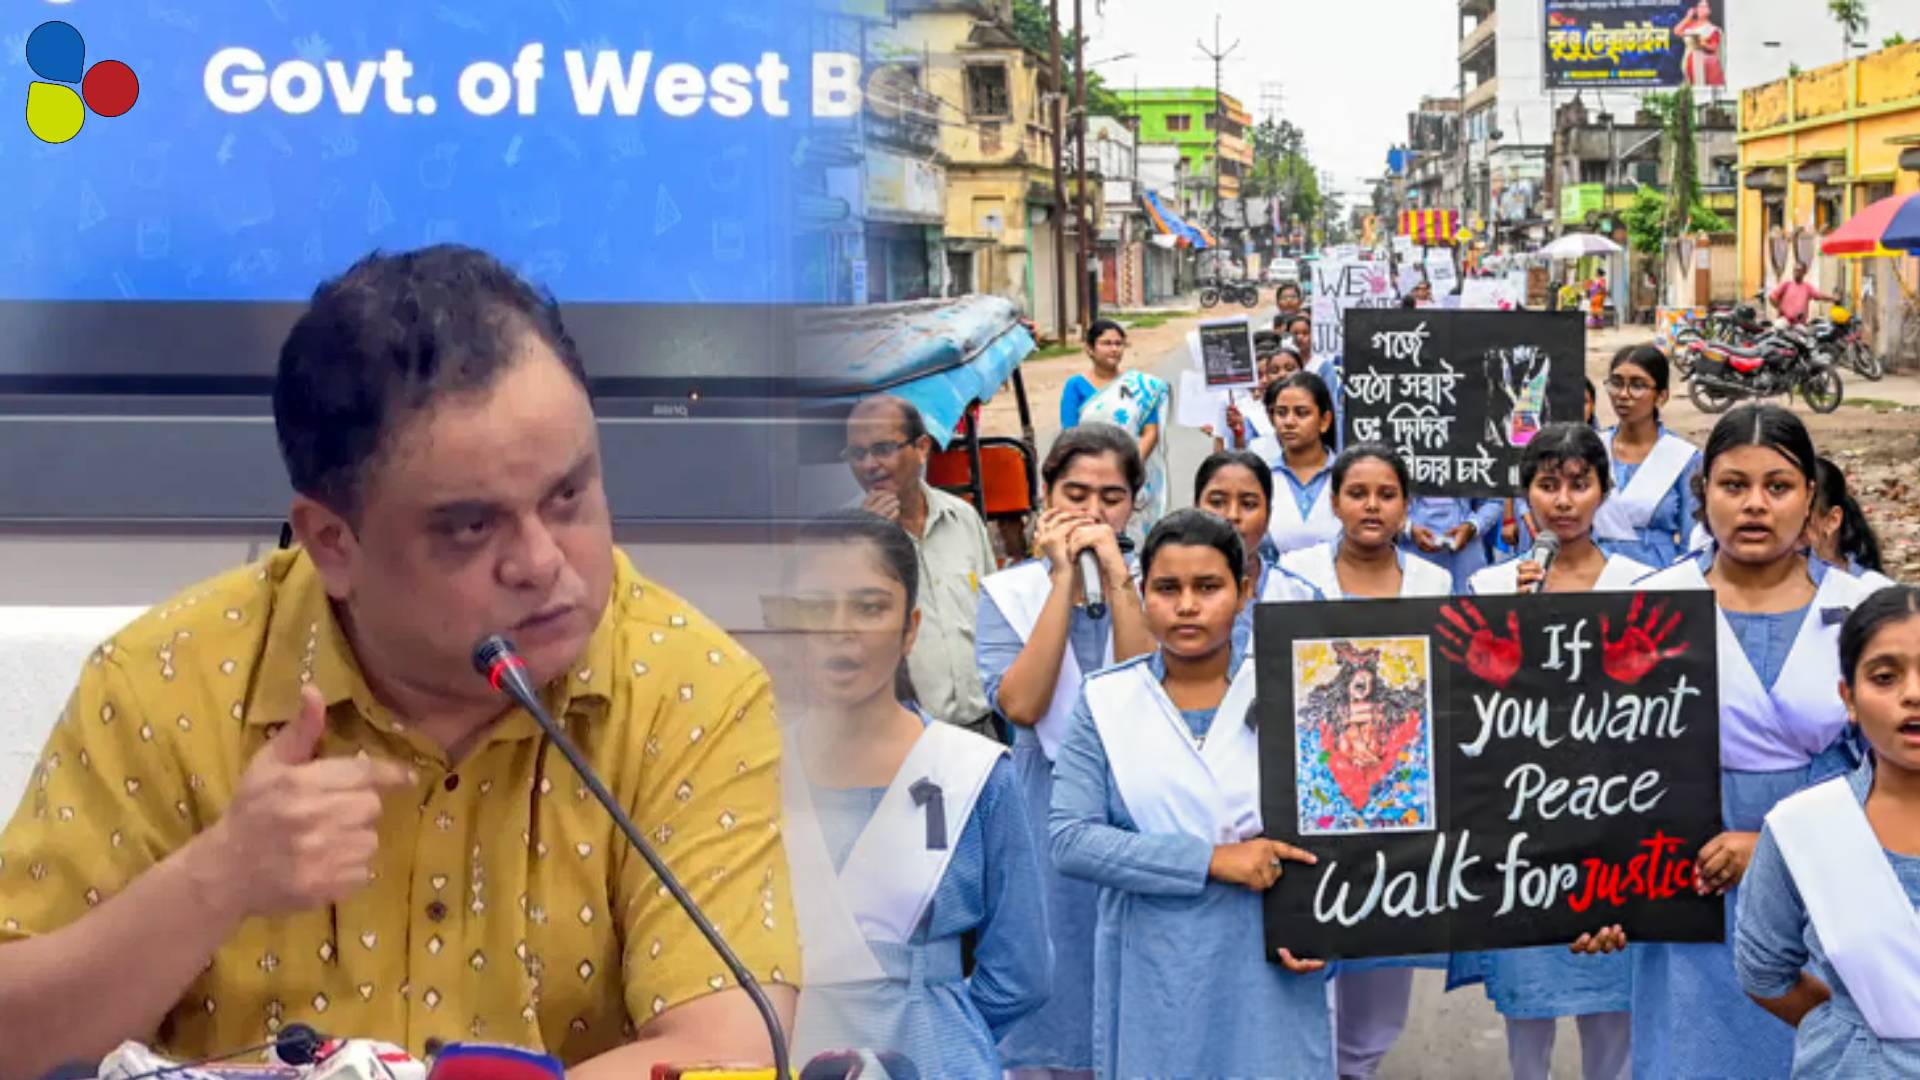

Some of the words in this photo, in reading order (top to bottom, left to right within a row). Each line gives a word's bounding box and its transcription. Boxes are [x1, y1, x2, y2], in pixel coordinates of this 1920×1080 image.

[204, 48, 437, 115] Govt.
[459, 43, 543, 115] of
[565, 51, 790, 117] West
[1318, 265, 1366, 298] WE
[1371, 321, 1430, 367] গর্জে
[1345, 366, 1394, 404] ওঠো
[1353, 416, 1382, 441] ডঃ
[1387, 403, 1455, 448] দিদির
[1455, 443, 1498, 487] চাই
[1542, 619, 1593, 681] If
[1459, 691, 1567, 757] you
[1504, 762, 1669, 820] Peace
[1314, 830, 1485, 927] Walk
[1496, 831, 1578, 917] for
